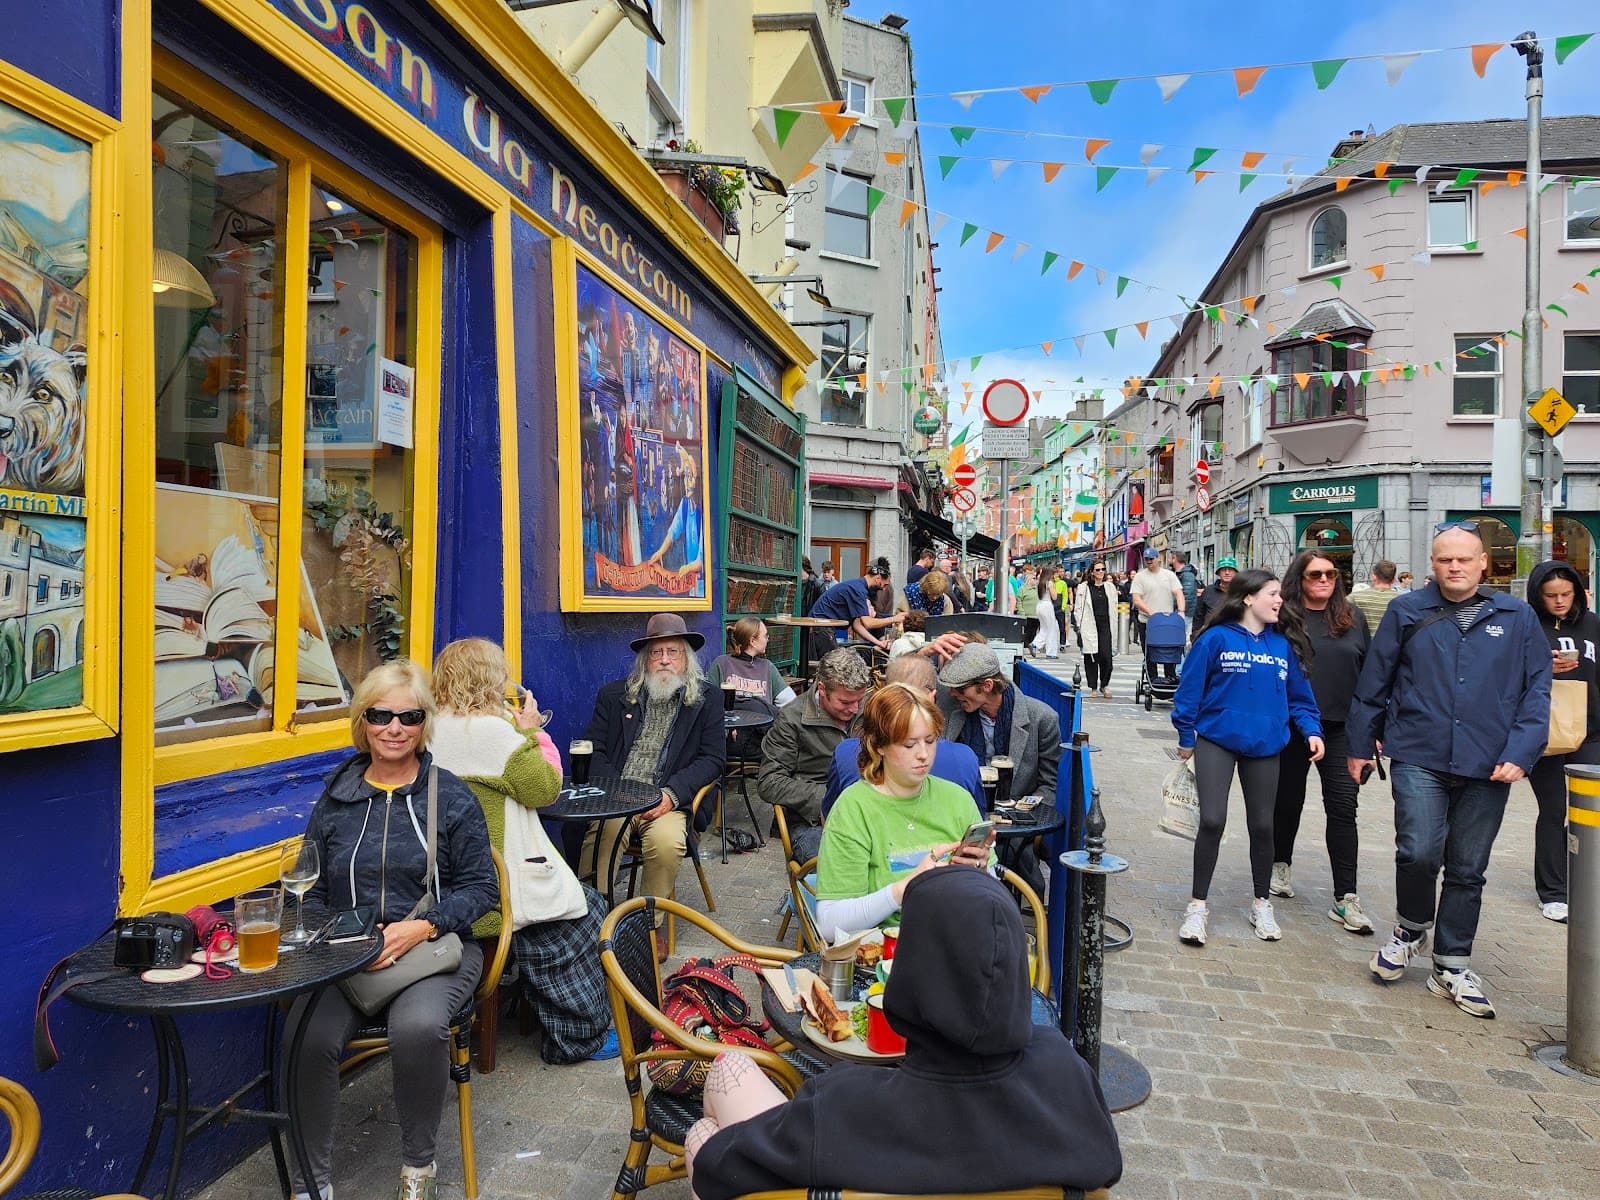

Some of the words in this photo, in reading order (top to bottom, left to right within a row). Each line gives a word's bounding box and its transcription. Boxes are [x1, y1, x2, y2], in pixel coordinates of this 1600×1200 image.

[1291, 486, 1356, 499] CARROLLS
[1220, 651, 1246, 661] new
[1247, 651, 1289, 669] balanc
